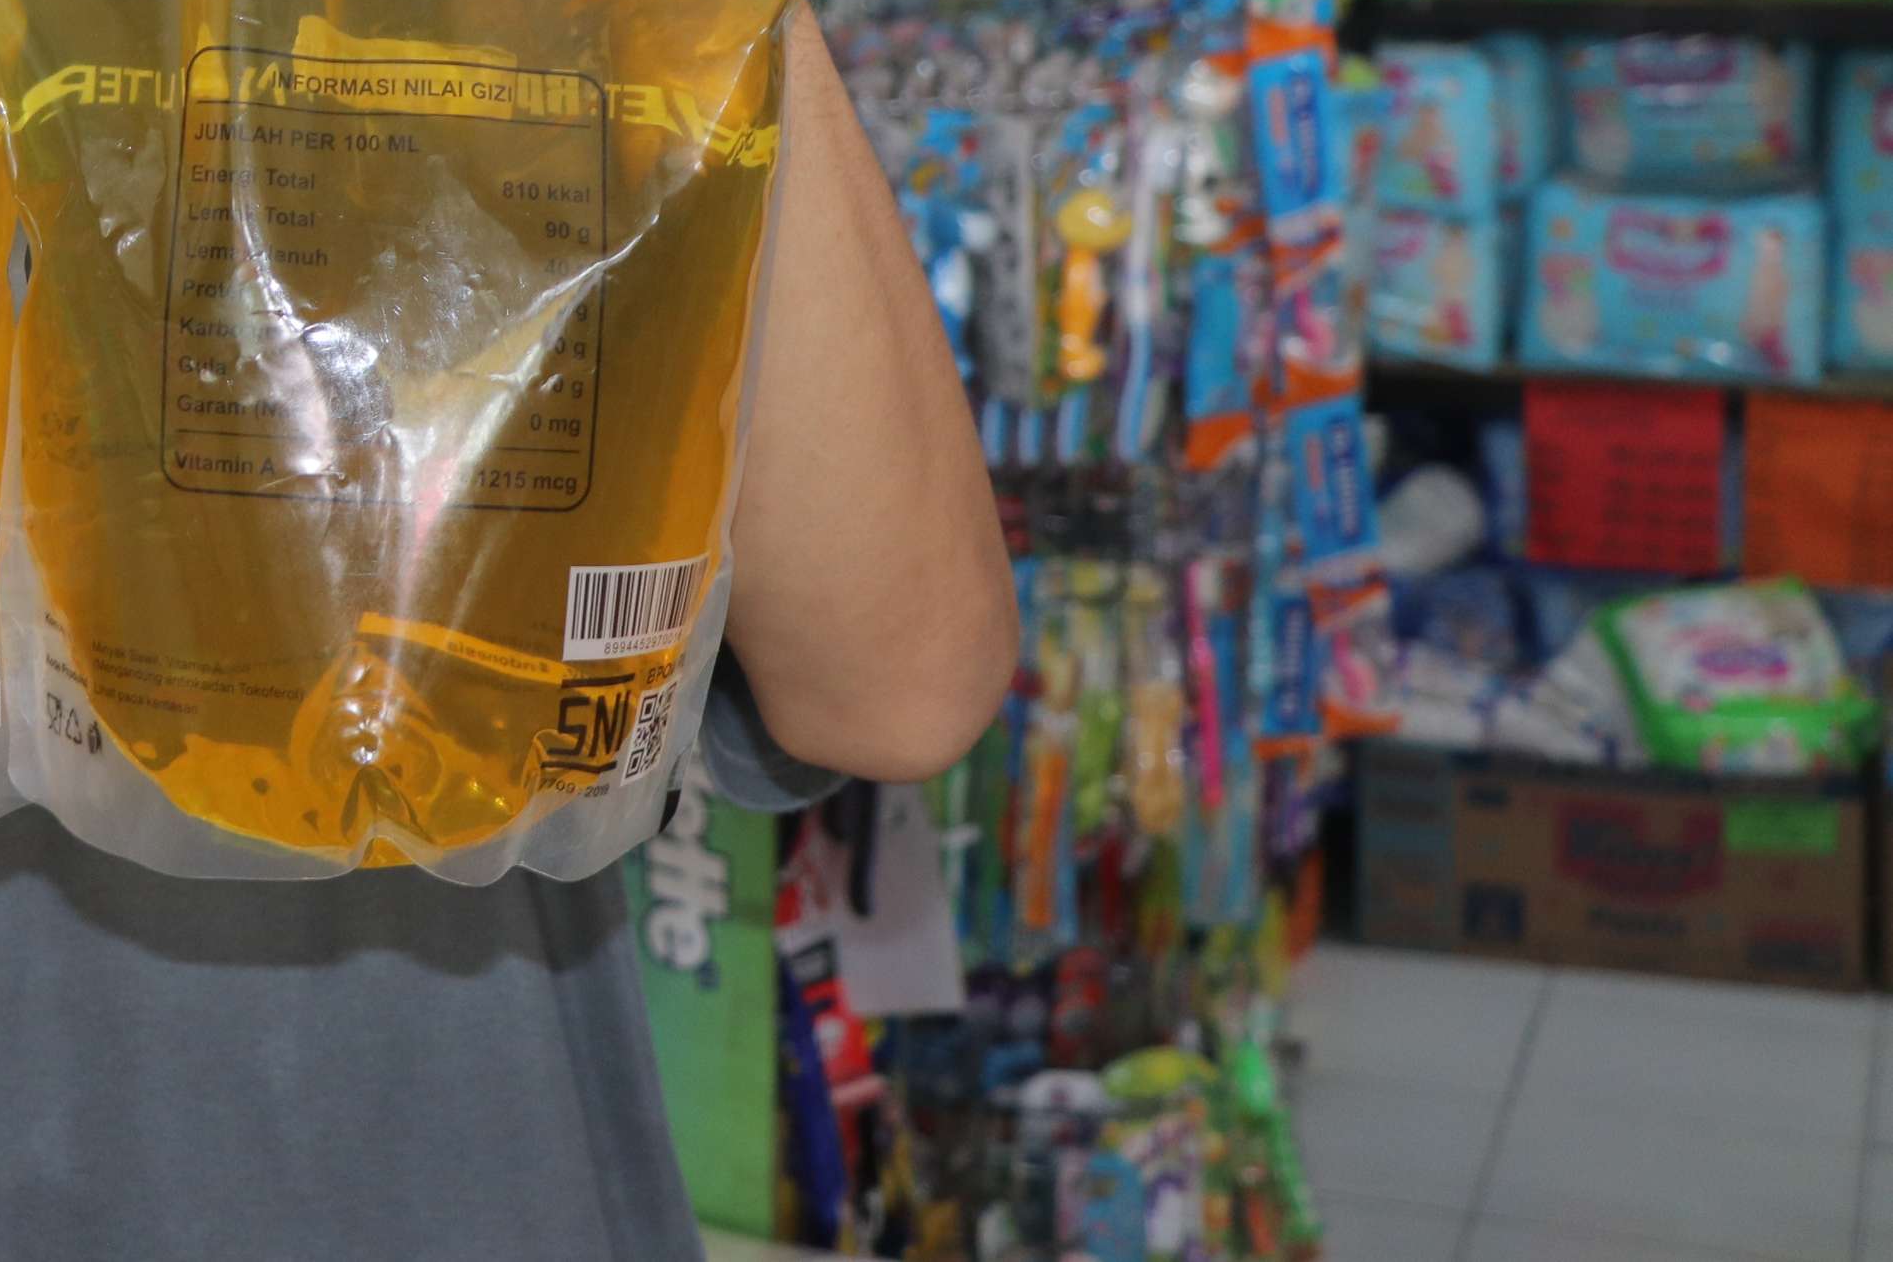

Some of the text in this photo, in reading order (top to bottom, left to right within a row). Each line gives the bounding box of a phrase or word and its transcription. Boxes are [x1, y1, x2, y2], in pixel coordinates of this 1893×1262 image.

[269, 69, 514, 104] INFORMASI NILAI GIZI
[194, 123, 420, 154] JUMLAH PER 100 ML
[265, 168, 316, 190] Total
[502, 180, 540, 201] 810
[547, 183, 591, 203] kkal
[265, 205, 316, 228] Total
[545, 220, 571, 240] 90
[577, 226, 591, 245] g
[572, 340, 587, 360] g
[571, 379, 585, 399] g
[176, 393, 247, 416] Garam
[529, 412, 541, 431] 0
[547, 413, 582, 436] mg
[174, 450, 578, 496] Vitamin A 1215 mcg
[547, 690, 632, 758] SNI
